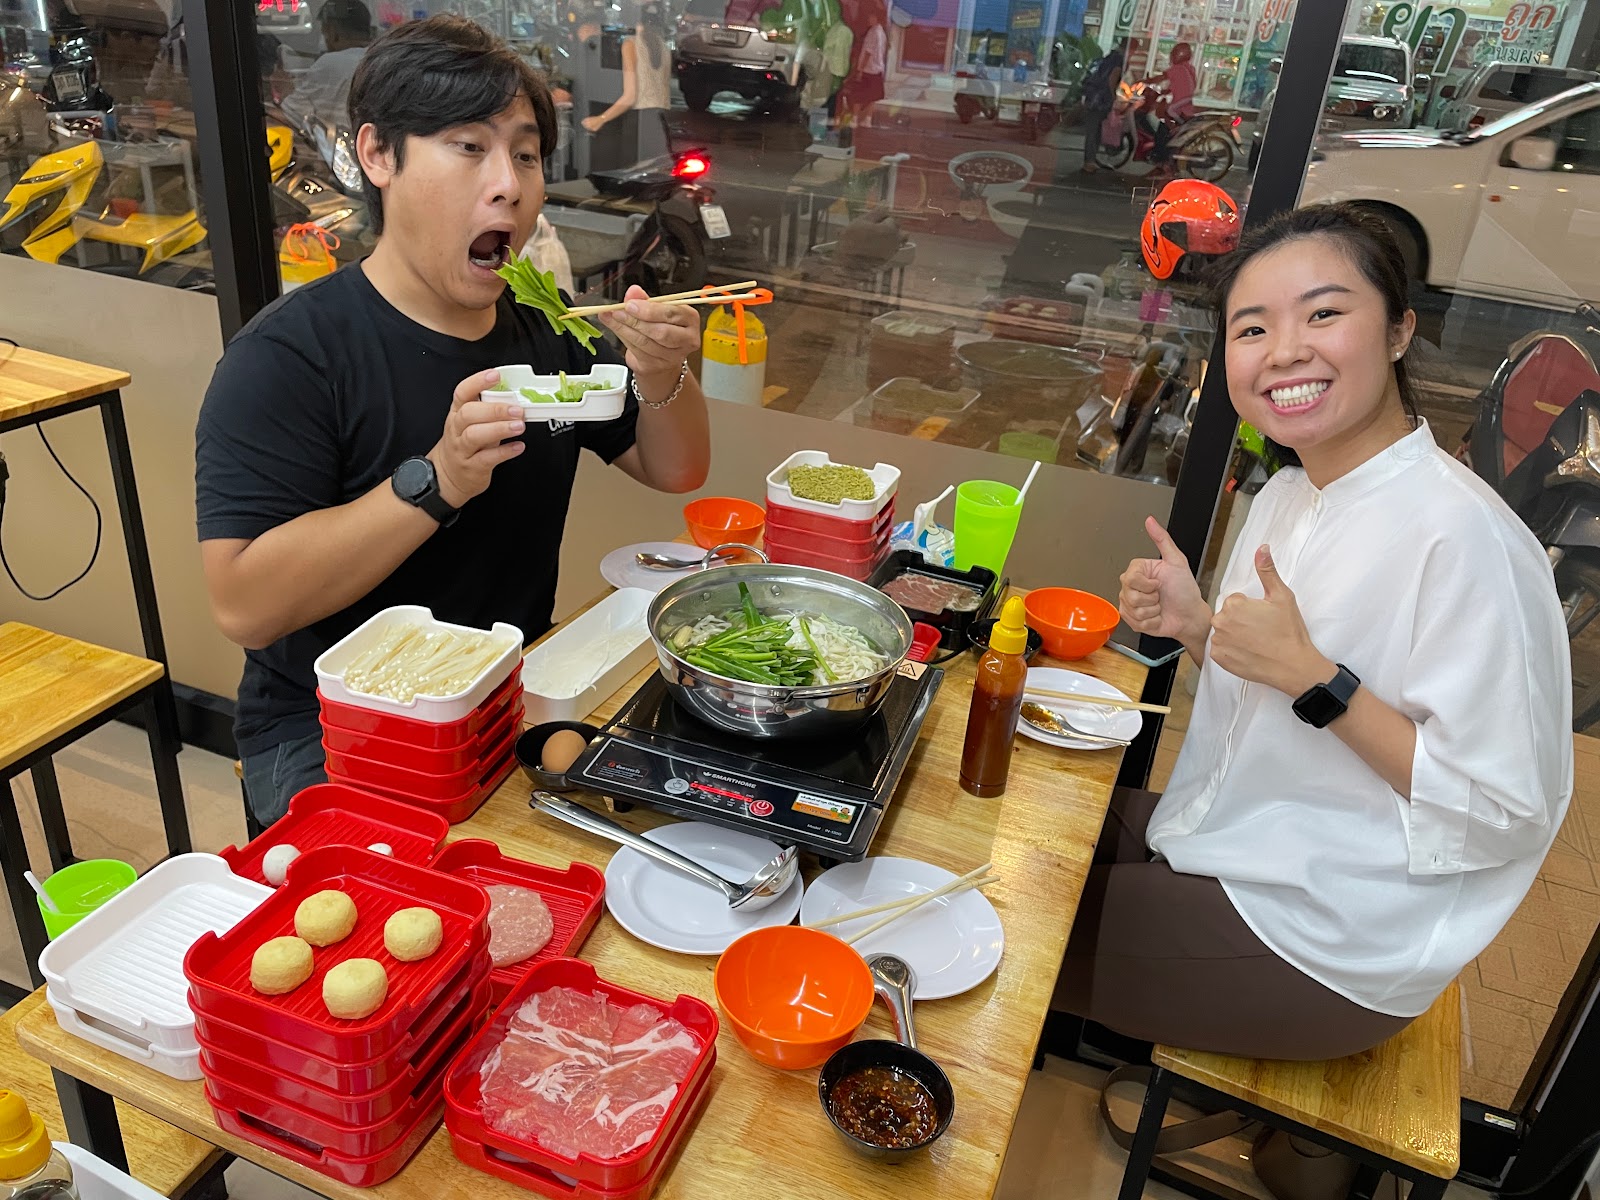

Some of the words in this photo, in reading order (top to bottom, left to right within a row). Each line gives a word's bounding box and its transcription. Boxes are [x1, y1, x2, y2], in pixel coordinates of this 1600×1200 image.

[1502, 3, 1557, 42] ถูก
[1496, 46, 1543, 65] นมผง
[712, 774, 757, 789] SMARTHOME
